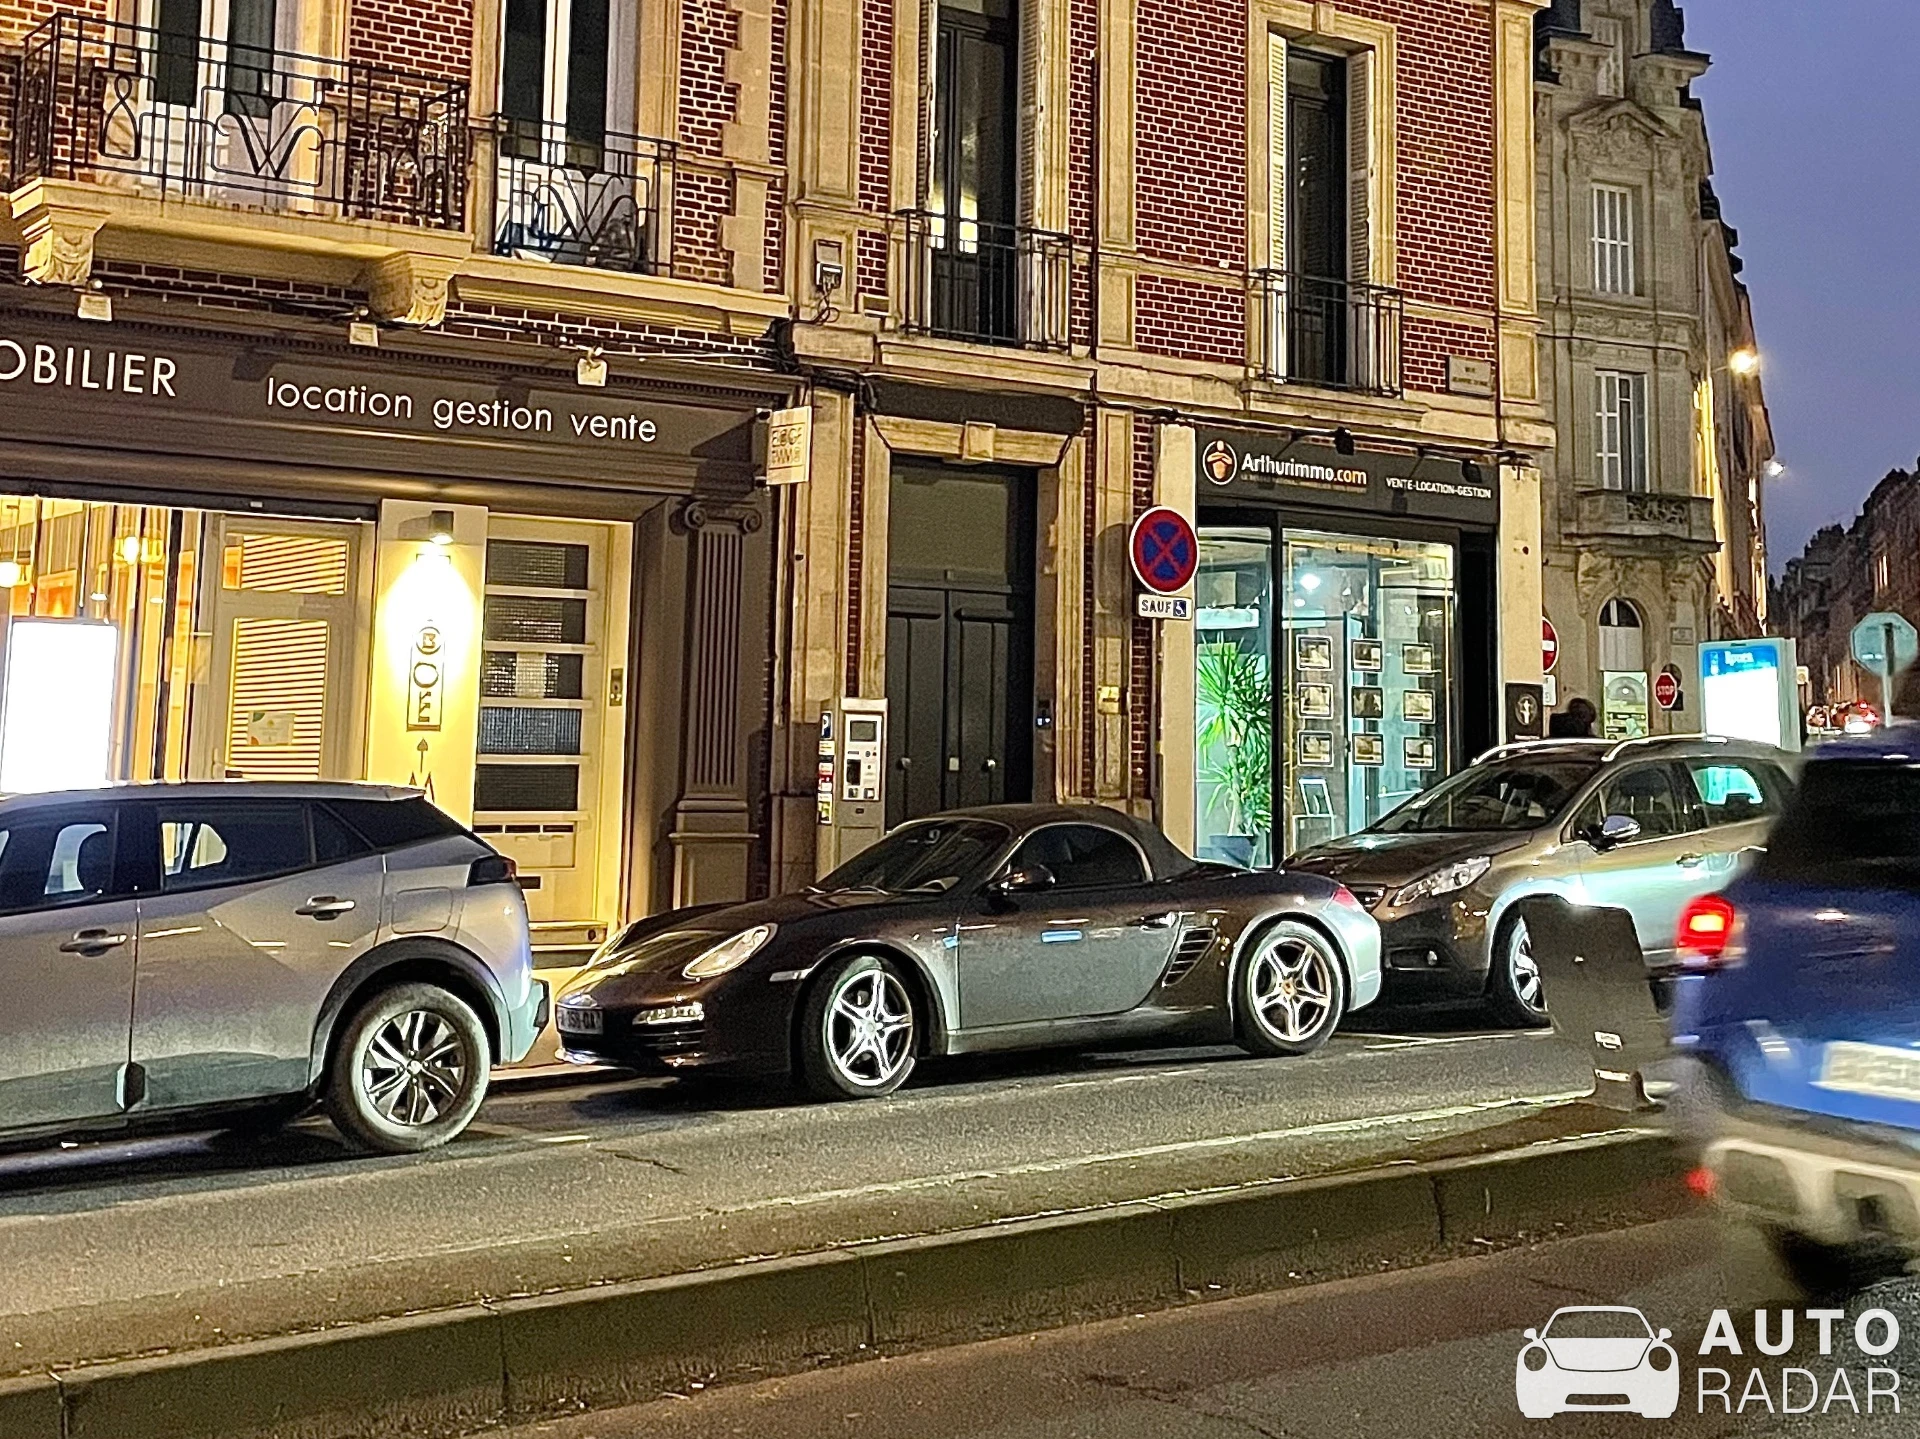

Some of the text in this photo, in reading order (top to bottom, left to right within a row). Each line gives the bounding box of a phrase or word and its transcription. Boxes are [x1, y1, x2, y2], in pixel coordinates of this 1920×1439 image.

[0, 339, 176, 397] OBILIER
[267, 377, 657, 442] location gestion vente
[1241, 452, 1367, 485] Arthurimmo.com
[1141, 600, 1171, 613] SAUF
[1657, 685, 1675, 696] STOP
